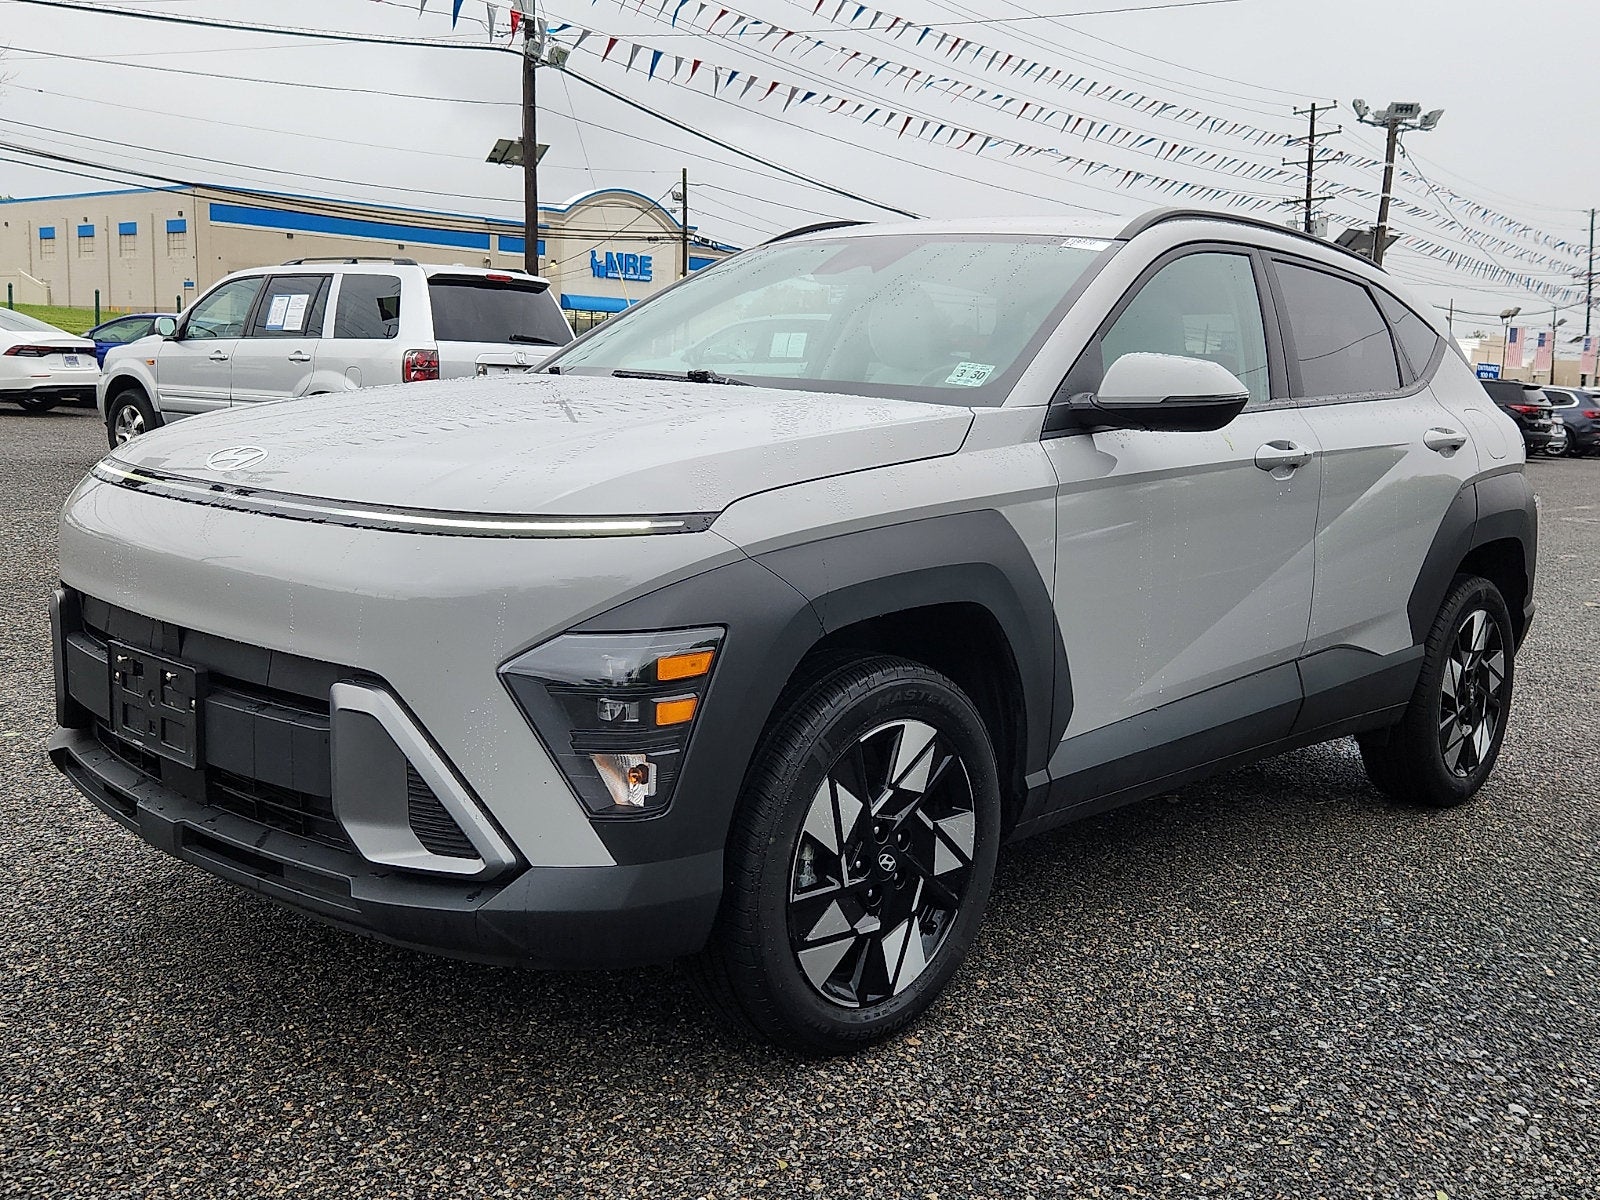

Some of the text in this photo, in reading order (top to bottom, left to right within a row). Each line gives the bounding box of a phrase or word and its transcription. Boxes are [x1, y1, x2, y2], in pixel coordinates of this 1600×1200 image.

[605, 251, 653, 276] MRE
[956, 368, 986, 380] 3 30
